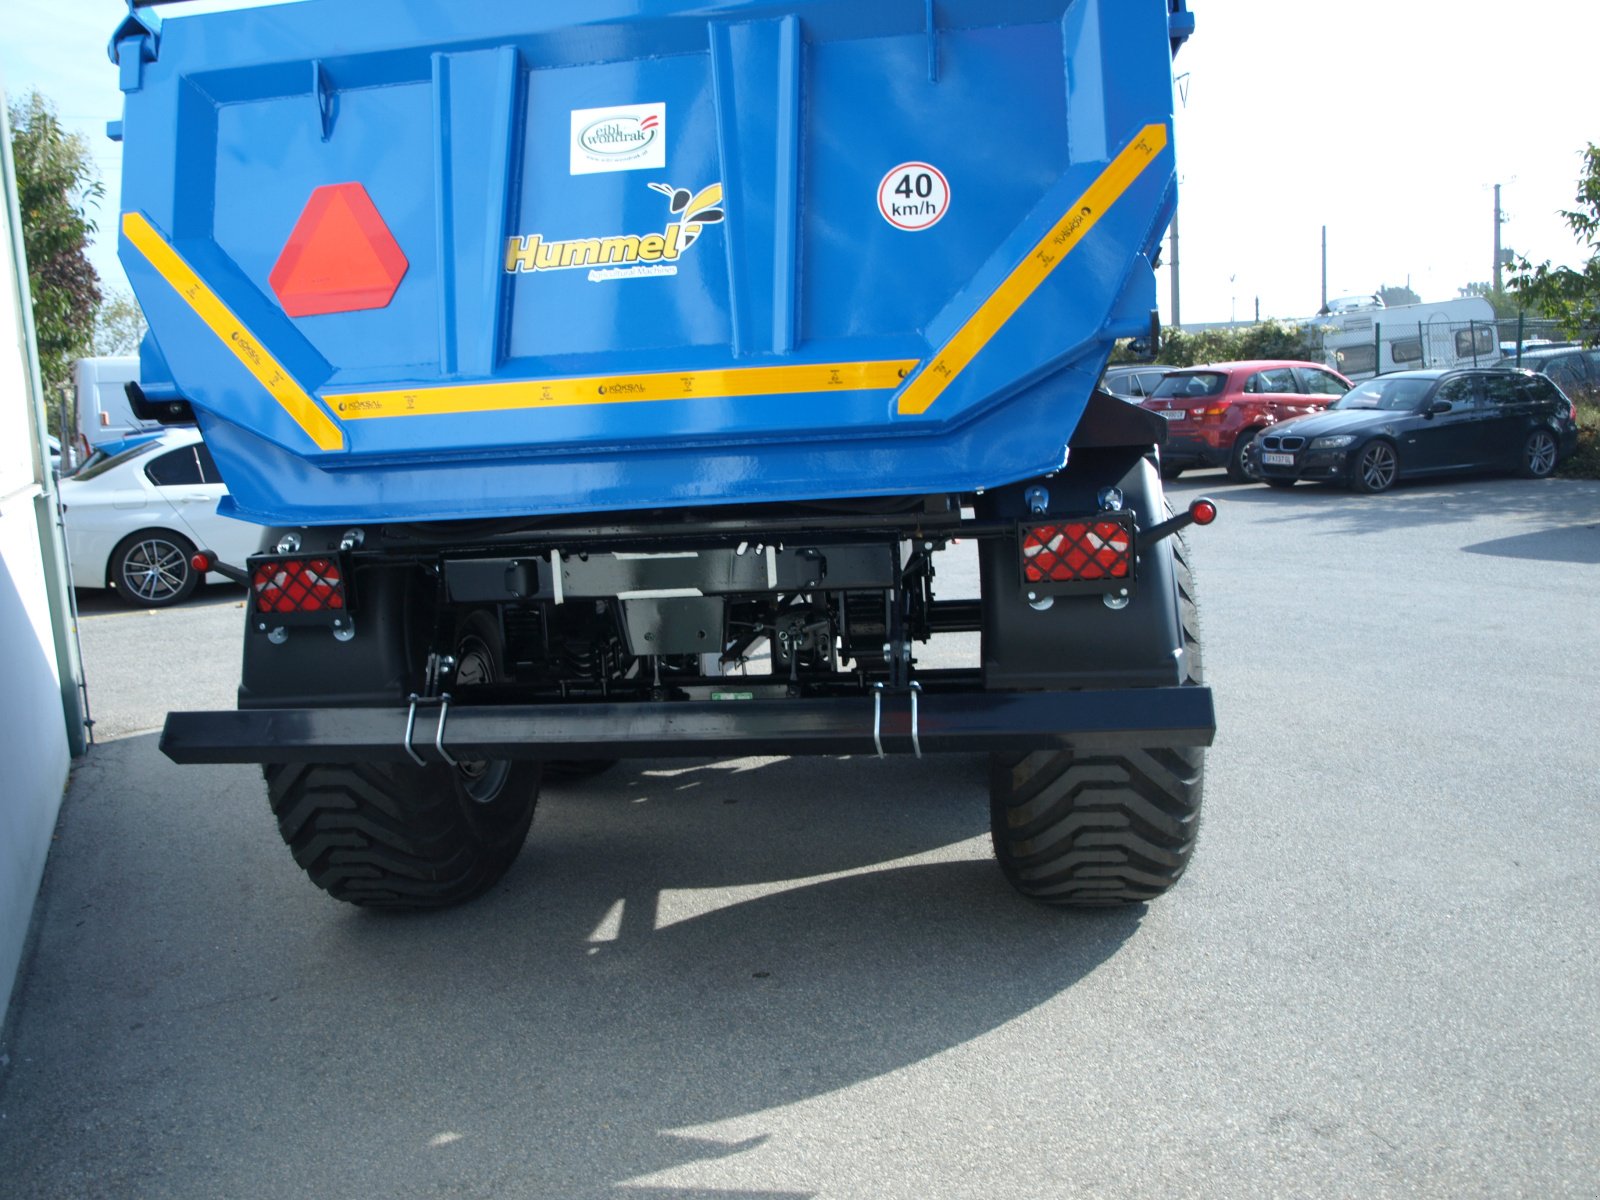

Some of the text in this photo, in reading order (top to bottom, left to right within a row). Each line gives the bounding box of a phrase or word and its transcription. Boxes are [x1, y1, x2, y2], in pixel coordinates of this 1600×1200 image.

[587, 130, 646, 145] wondrak
[894, 172, 933, 199] 40
[891, 200, 937, 217] km/h
[504, 223, 682, 272] Hummel
